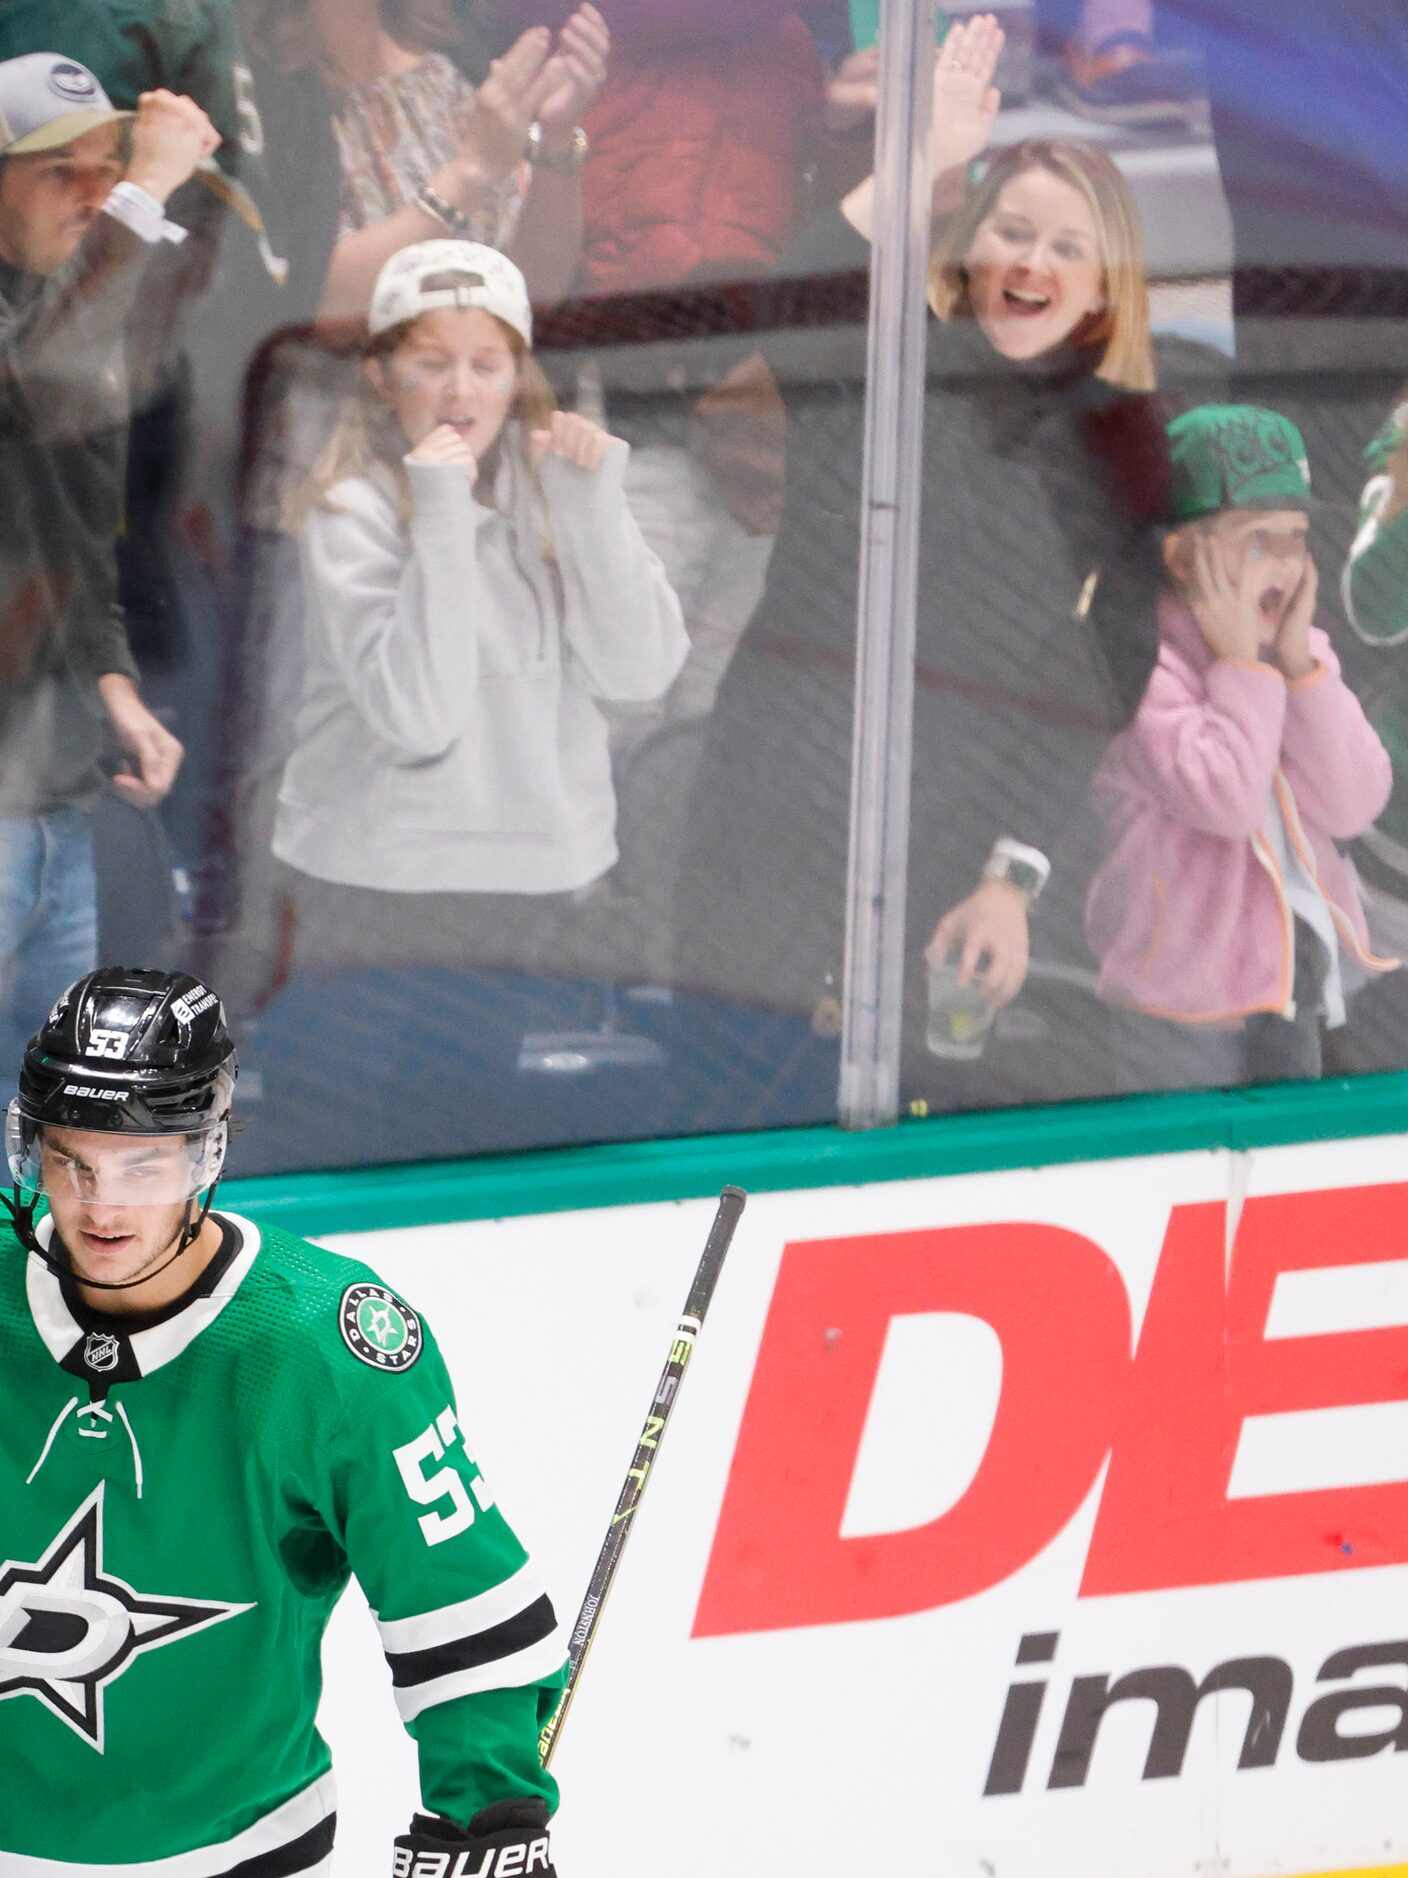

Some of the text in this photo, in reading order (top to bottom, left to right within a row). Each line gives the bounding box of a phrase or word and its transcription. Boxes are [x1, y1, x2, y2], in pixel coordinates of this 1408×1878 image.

[181, 984, 207, 1005] ENERGY
[85, 1029, 128, 1060] 53
[345, 1288, 418, 1366] DALLAS STARS
[91, 1345, 113, 1362] NHL
[571, 1593, 600, 1647] JOHNSTON
